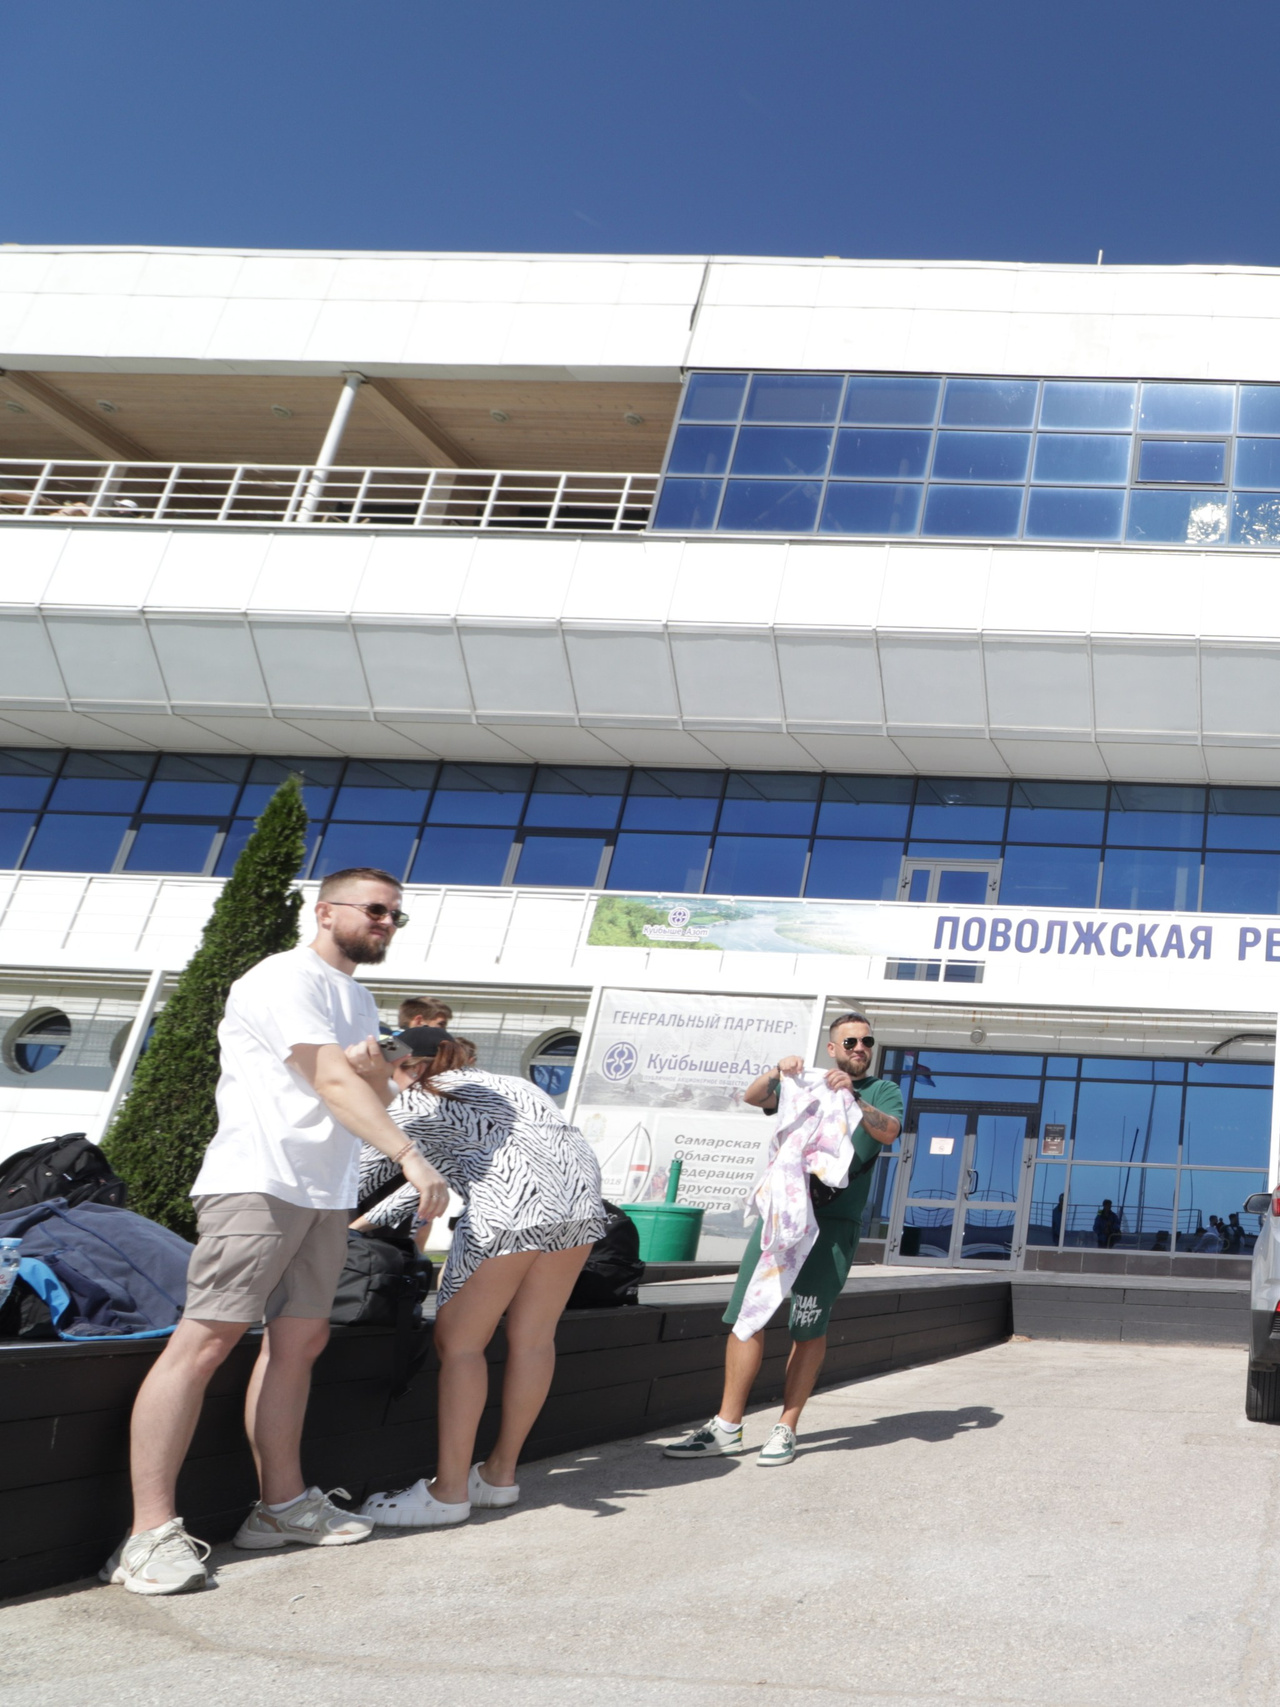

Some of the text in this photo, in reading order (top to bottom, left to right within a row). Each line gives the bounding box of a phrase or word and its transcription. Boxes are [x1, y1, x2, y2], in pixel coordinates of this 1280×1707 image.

[933, 915, 1213, 960] ПОВОЛЖСКАЯ
[612, 1010, 798, 1035] ГЕНЕРАЛЬНЫЙ ПАРТНЕР:
[647, 1053, 776, 1077] КуйбышевАзо
[677, 1076, 718, 1084] АКЦИОНЕРНОЕ
[719, 1079, 749, 1087] ОБЩЕСТВО
[674, 1134, 761, 1150] Самарская
[674, 1149, 755, 1165] Областная
[668, 1167, 754, 1181] едерация
[676, 1183, 748, 1196] арусного
